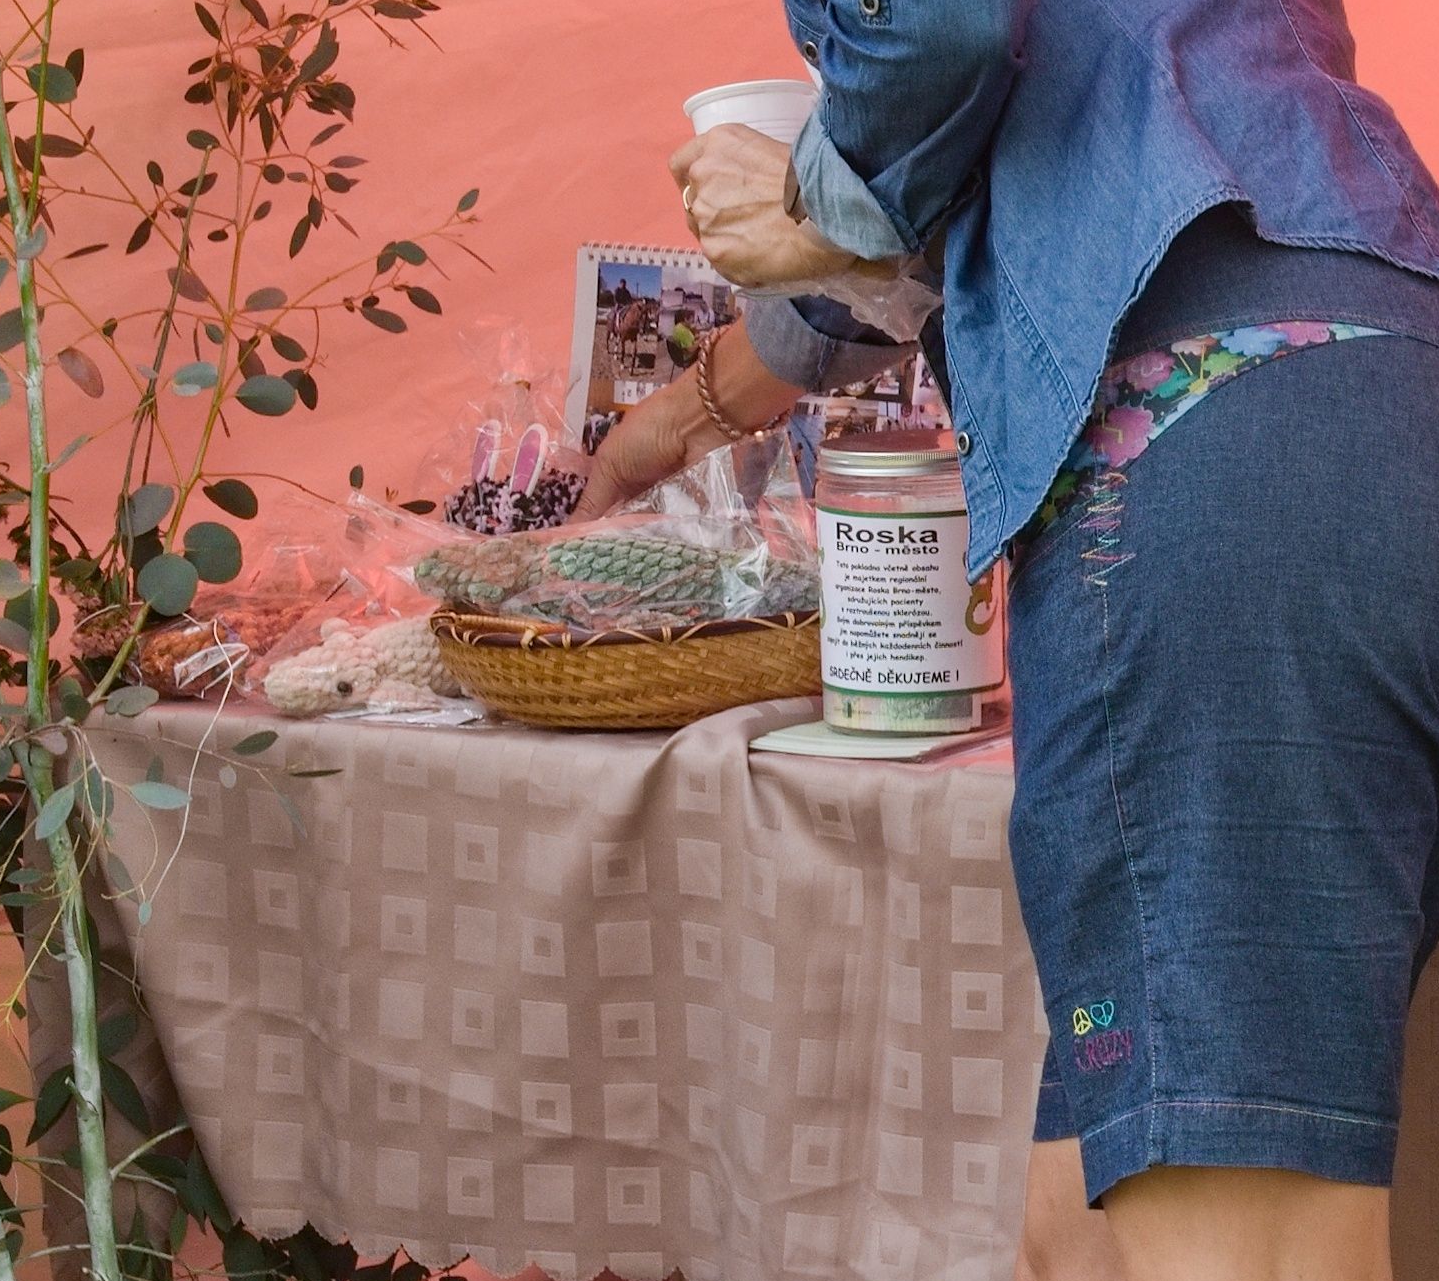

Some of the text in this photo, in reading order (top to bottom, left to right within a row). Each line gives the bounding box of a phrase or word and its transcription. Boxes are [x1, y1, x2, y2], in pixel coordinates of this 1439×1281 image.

[836, 522, 938, 544] Roska
[837, 542, 869, 555] Brno
[885, 545, 939, 555] město
[869, 586, 889, 594] Roska
[891, 598, 923, 607] pacienty
[829, 665, 872, 683] SRDEČNĚ
[878, 668, 950, 684] DĚKUJEME
